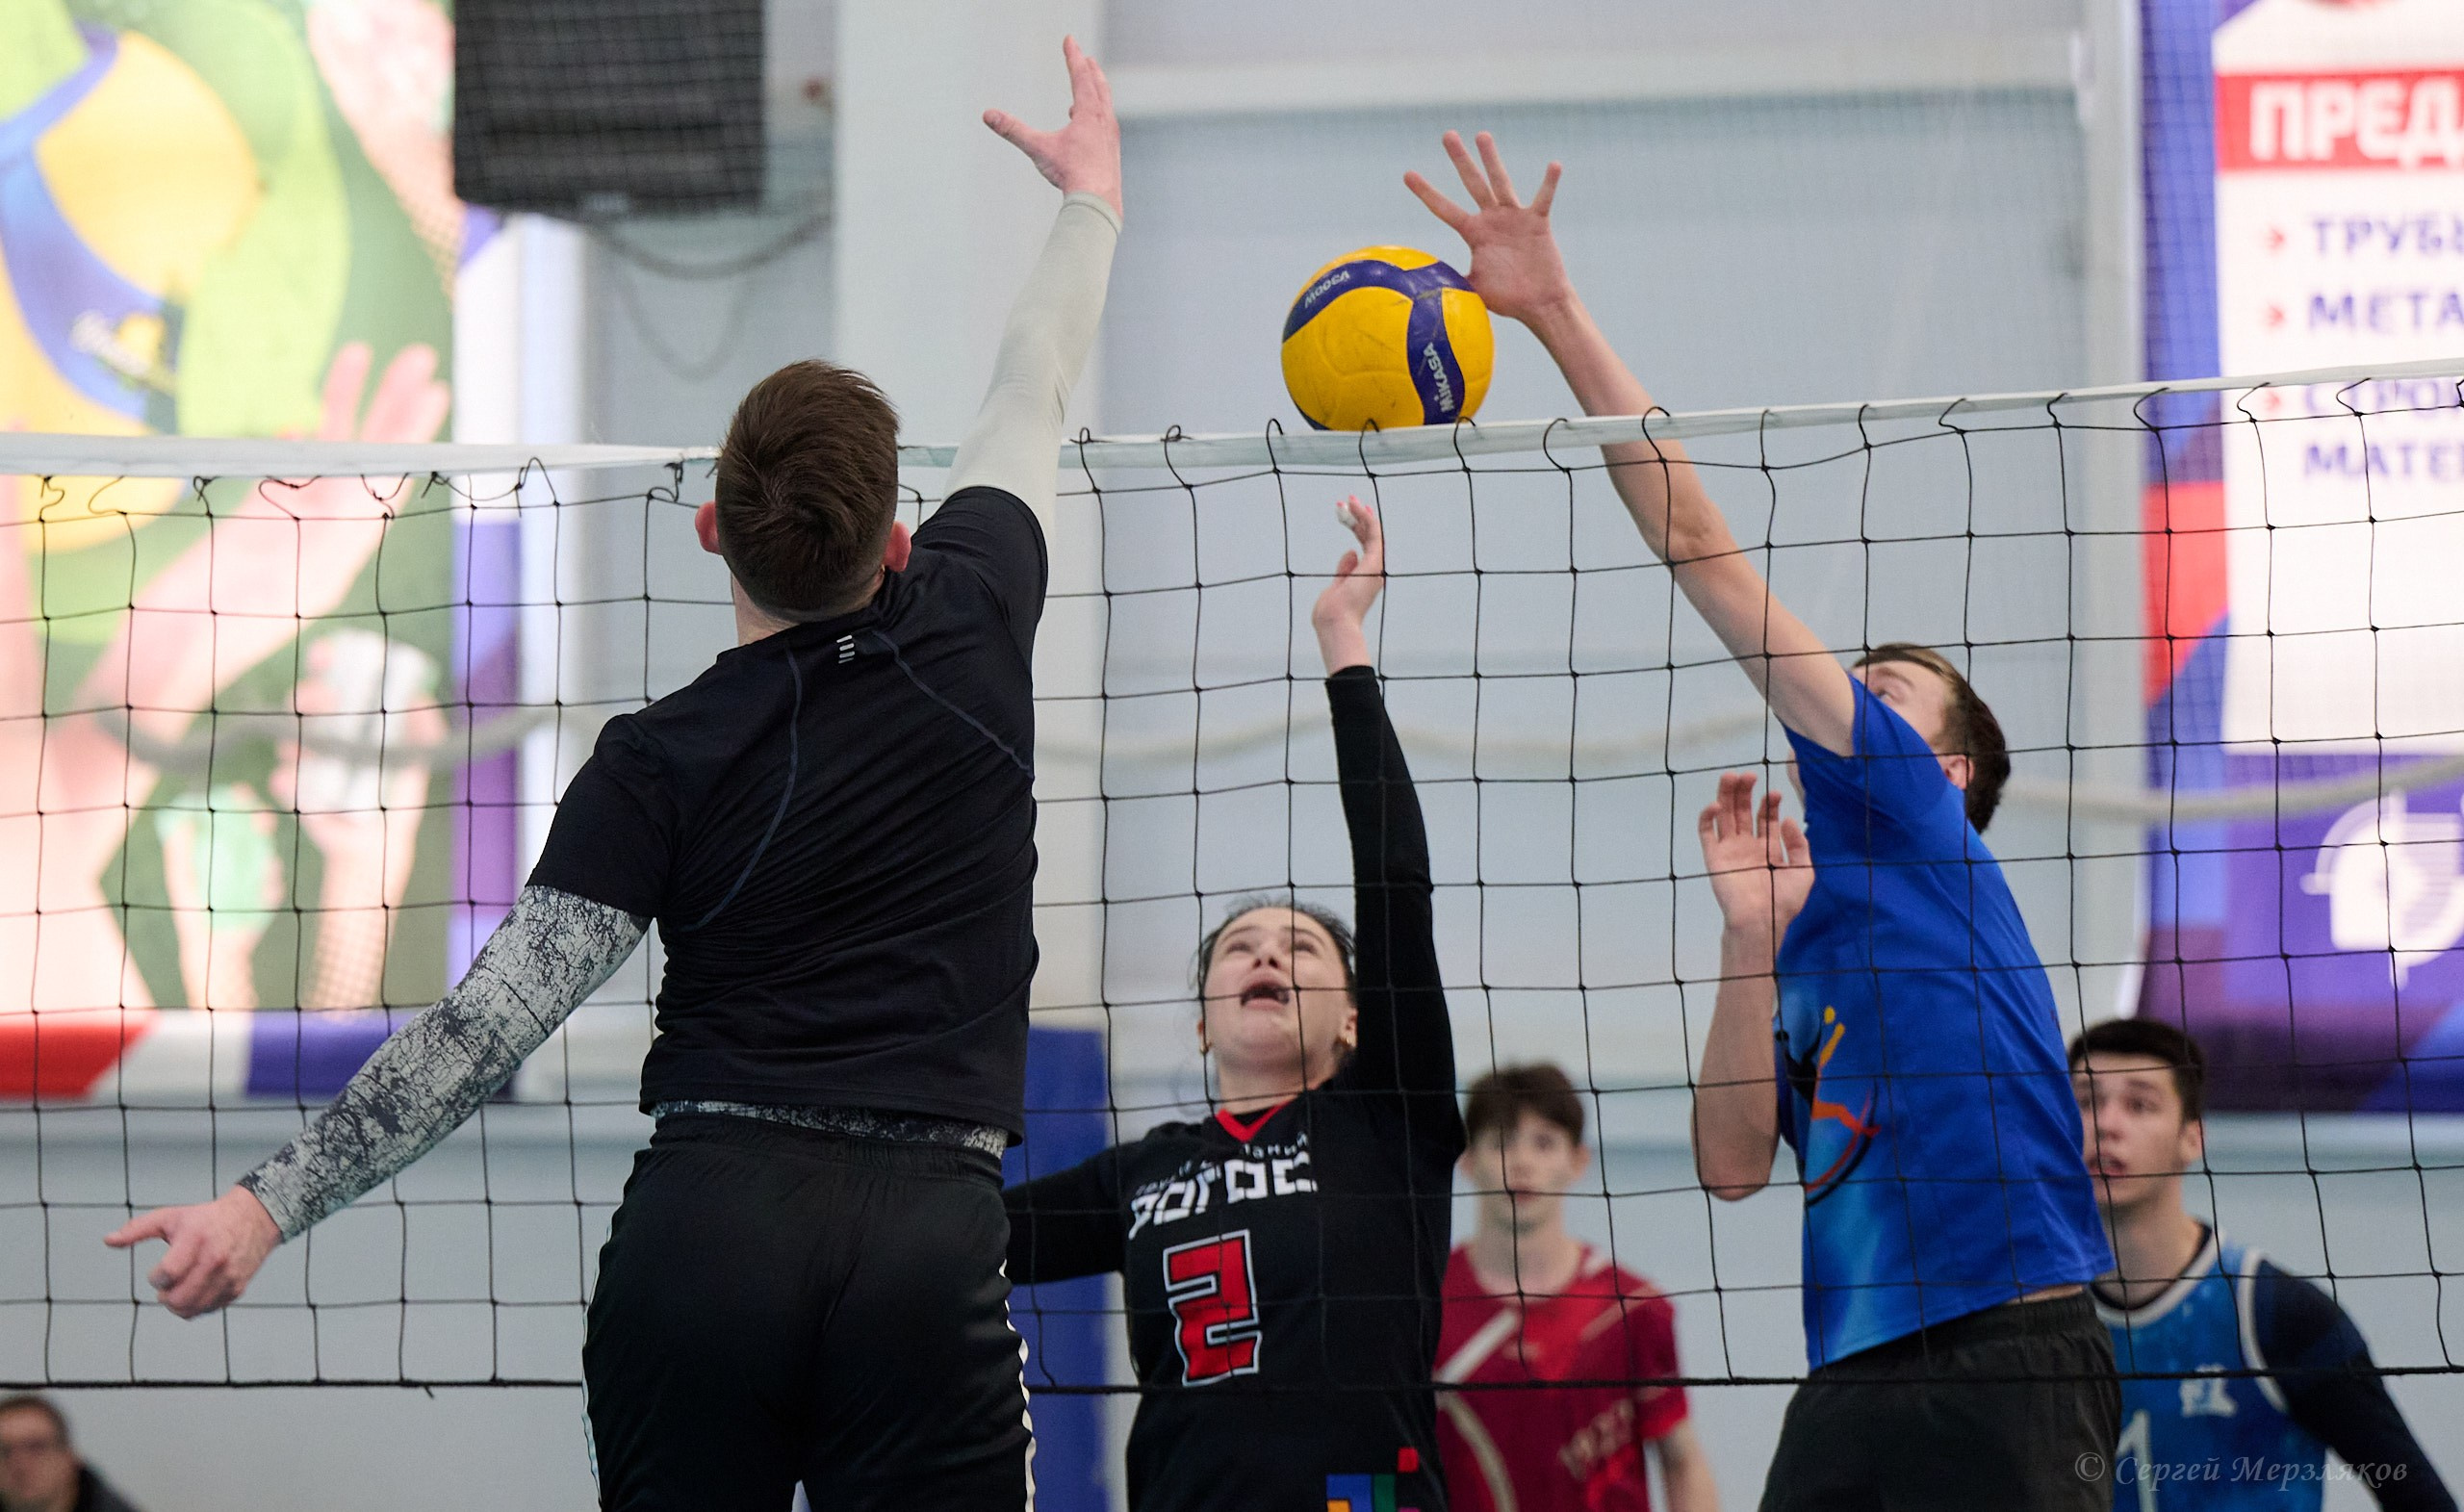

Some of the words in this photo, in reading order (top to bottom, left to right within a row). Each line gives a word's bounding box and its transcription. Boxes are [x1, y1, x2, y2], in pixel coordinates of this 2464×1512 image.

[2250, 79, 2464, 167] ПРЕД
[2304, 442, 2464, 477] МАТЕ
[1163, 1228, 1263, 1388] 2
